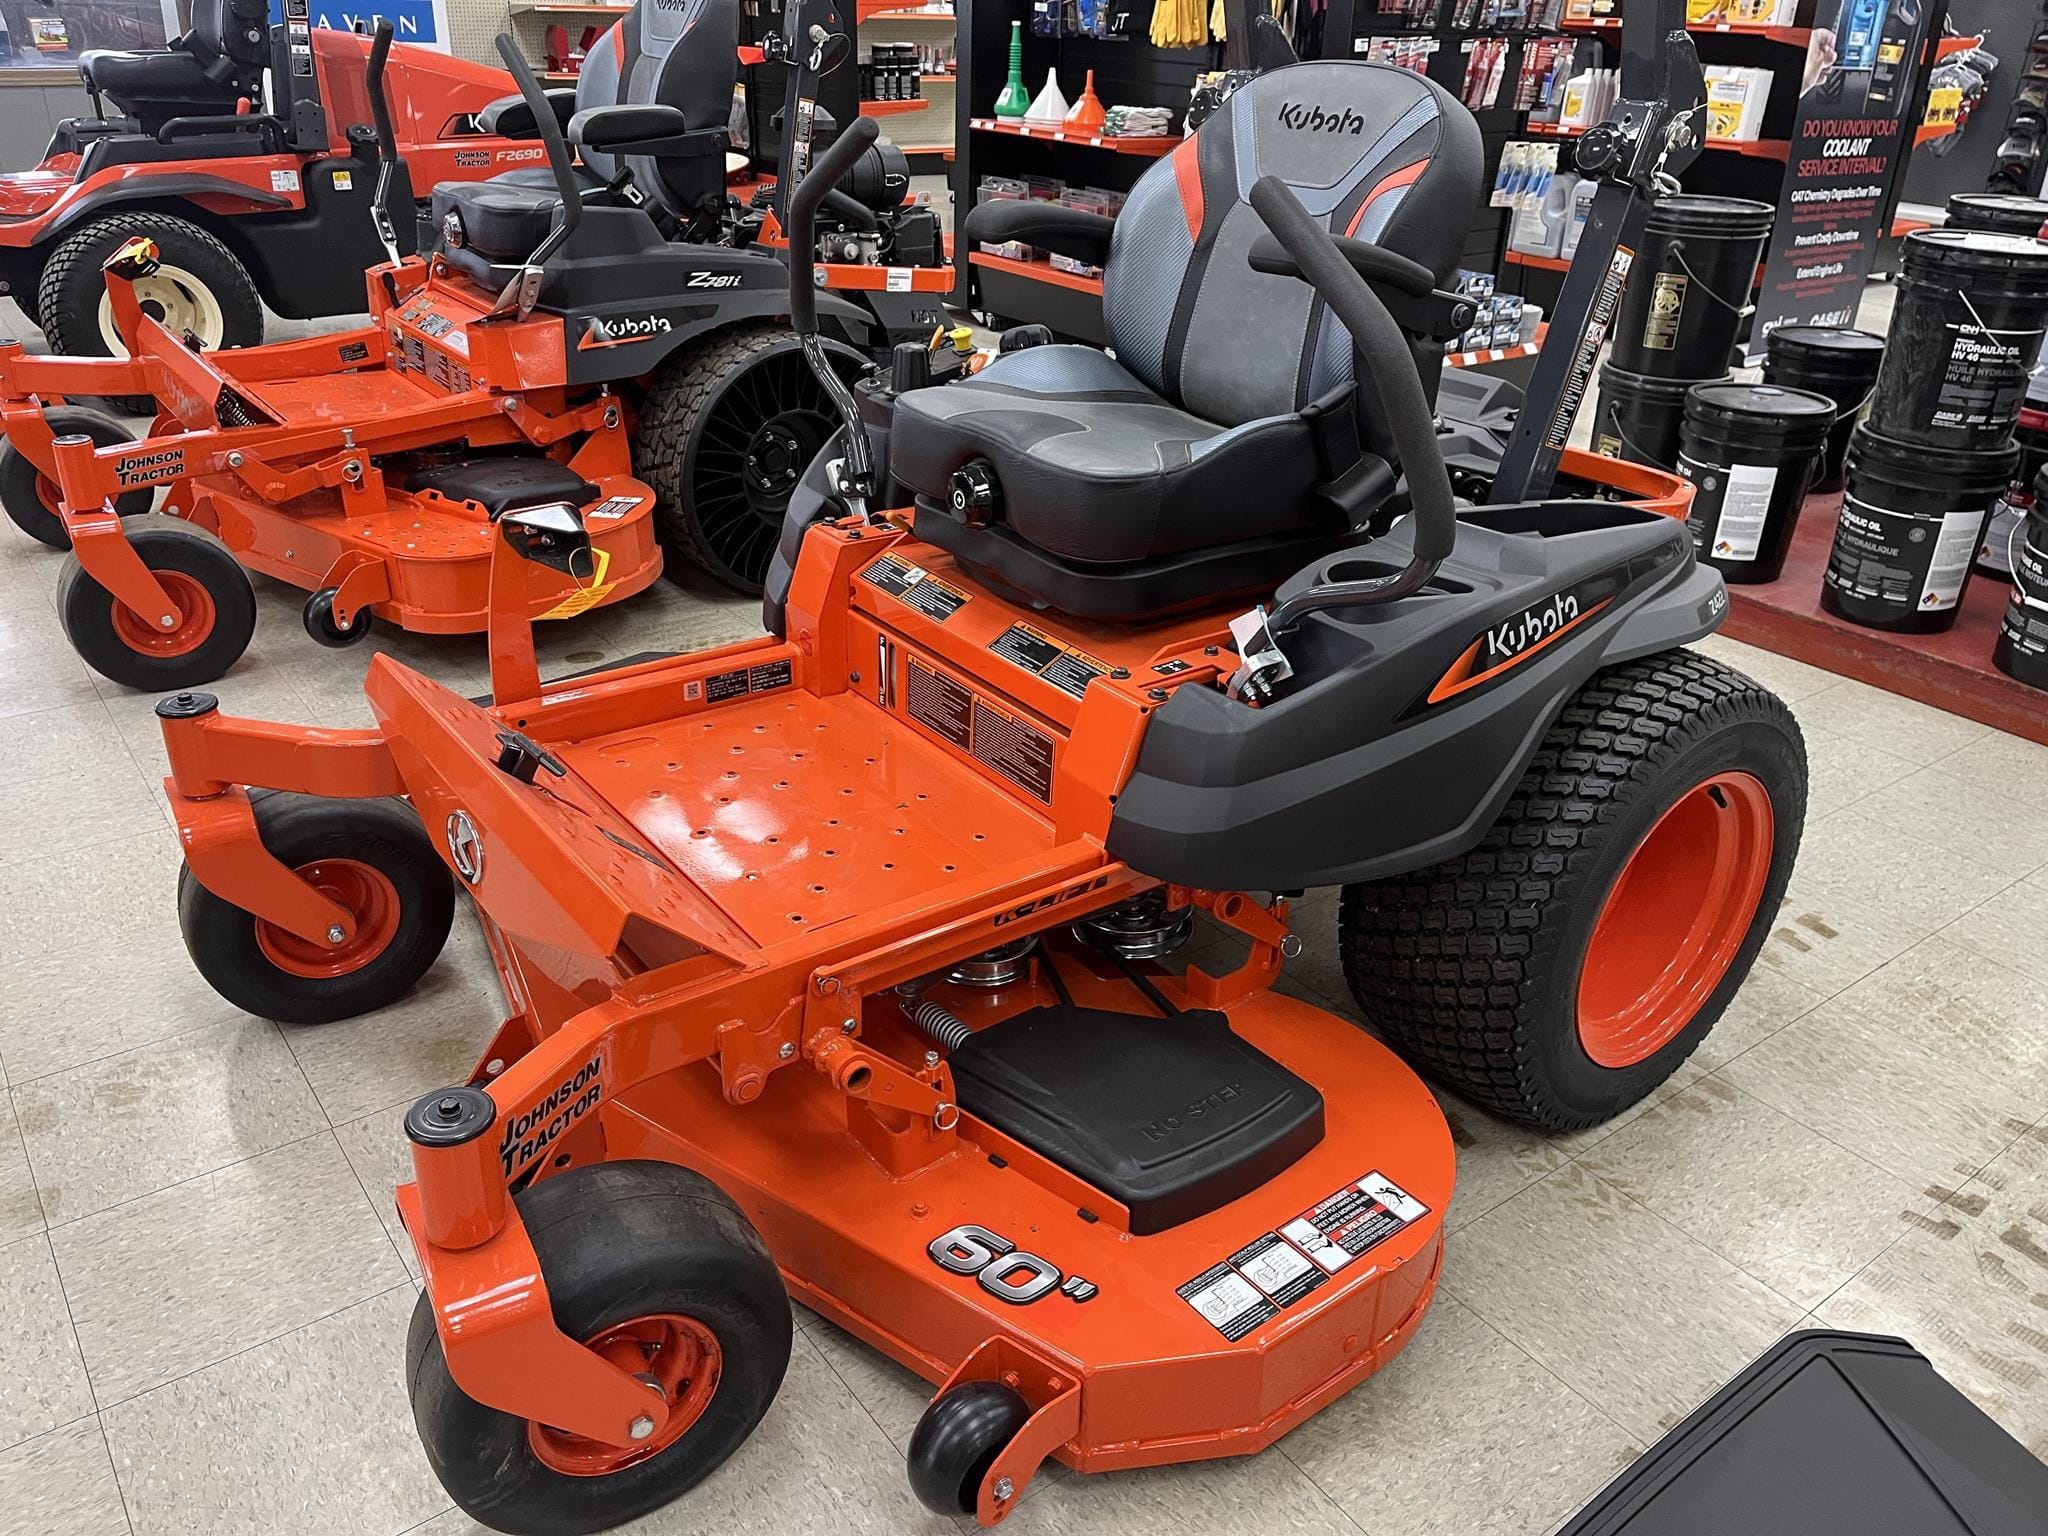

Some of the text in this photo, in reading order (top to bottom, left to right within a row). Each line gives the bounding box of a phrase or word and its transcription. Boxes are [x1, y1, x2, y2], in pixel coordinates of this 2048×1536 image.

[1278, 102, 1365, 135] Kubota
[1803, 119, 1899, 138] DO YOU KNOW YOUR
[454, 151, 490, 159] JOHNSON
[496, 149, 543, 161] F2690
[1822, 138, 1873, 157] COOLANT
[456, 159, 490, 168] TRACTOR
[1798, 159, 1841, 177] SERVICE
[687, 271, 742, 288] Z781i
[600, 314, 673, 337] Kubota
[911, 309, 938, 324] HOT
[1810, 310, 1841, 327] CASE
[1951, 351, 1966, 360] HV
[1954, 342, 2020, 356] HYDRAULIC OIL
[1948, 364, 1976, 374] HUILE
[115, 450, 184, 473] JOHNSON
[118, 463, 185, 487] TRACTOR
[1488, 593, 1579, 656] Kubota
[499, 1056, 601, 1155] JOHNSON
[502, 1084, 601, 1179] TRACTOR
[1142, 1117, 1184, 1141] NO
[1320, 1190, 1350, 1211] DANGER
[1318, 1211, 1329, 1220] NOT
[1326, 1205, 1338, 1214] PUT
[1346, 1209, 1378, 1231] PELIGRO
